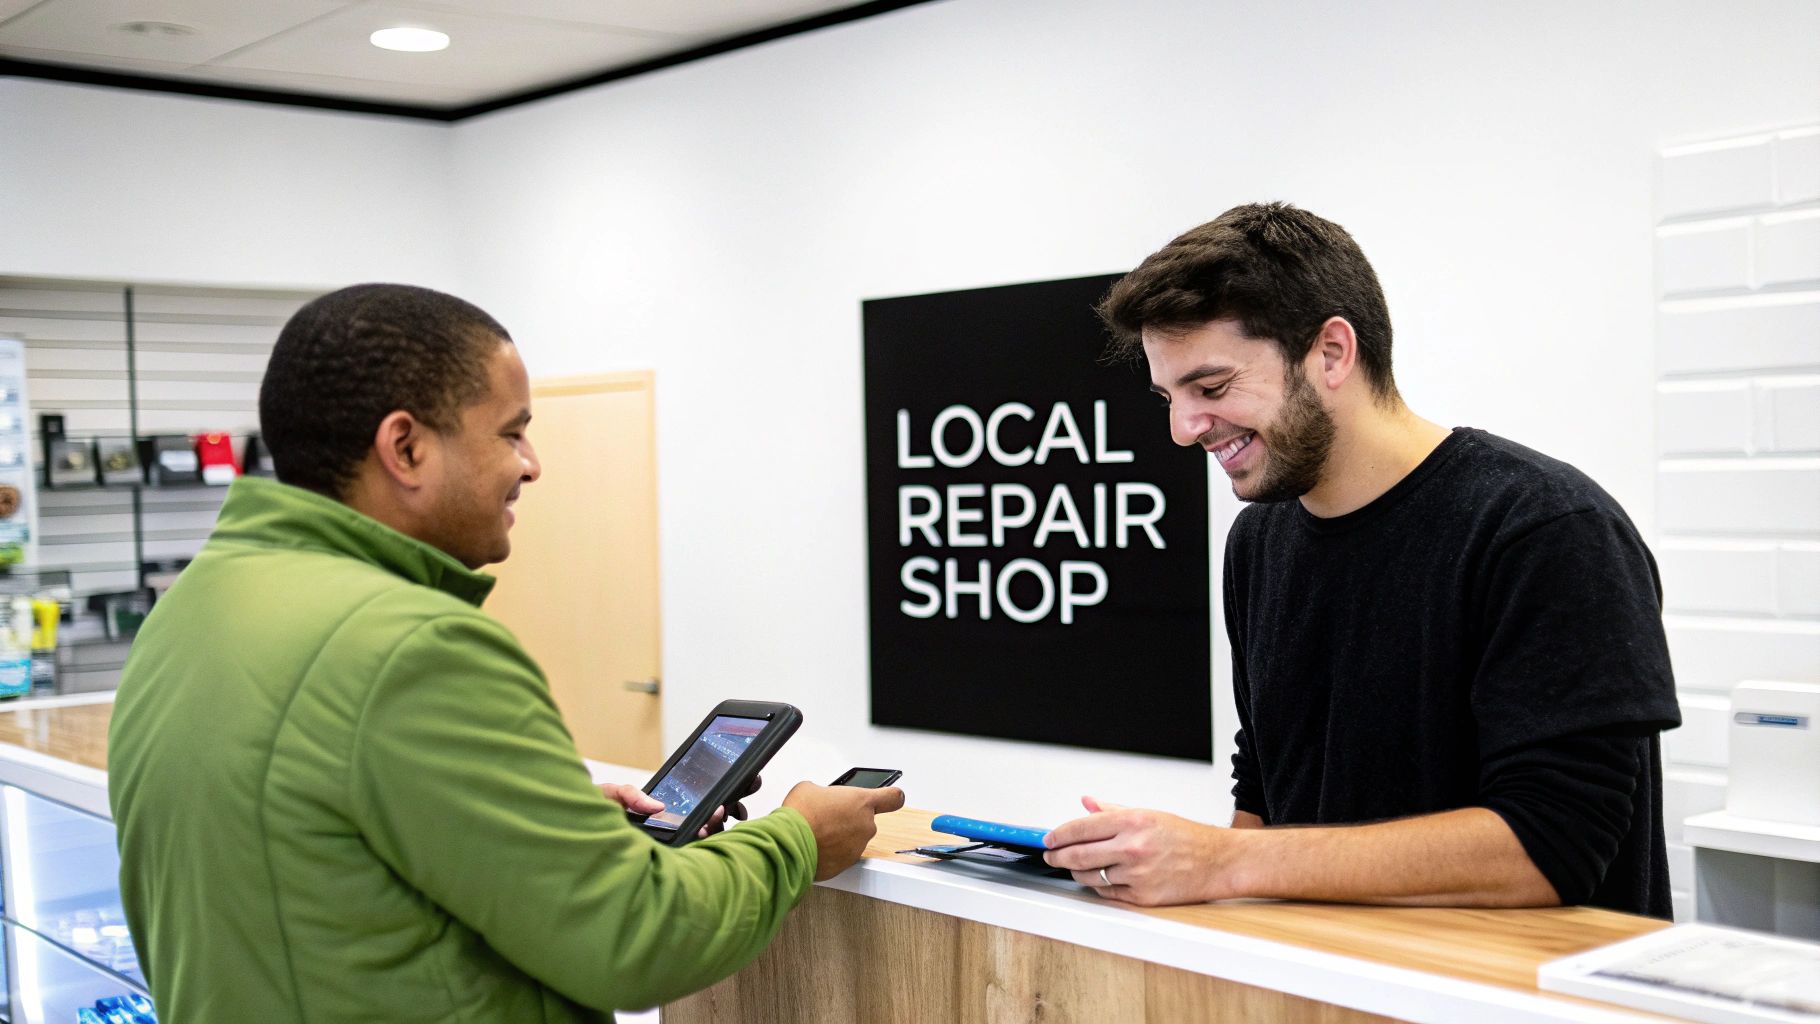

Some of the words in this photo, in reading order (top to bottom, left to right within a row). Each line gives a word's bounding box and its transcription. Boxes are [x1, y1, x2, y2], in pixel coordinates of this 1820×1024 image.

[897, 400, 1135, 469] LOCAL
[898, 482, 1166, 549] REPAIR
[900, 556, 1109, 625] SHOP
